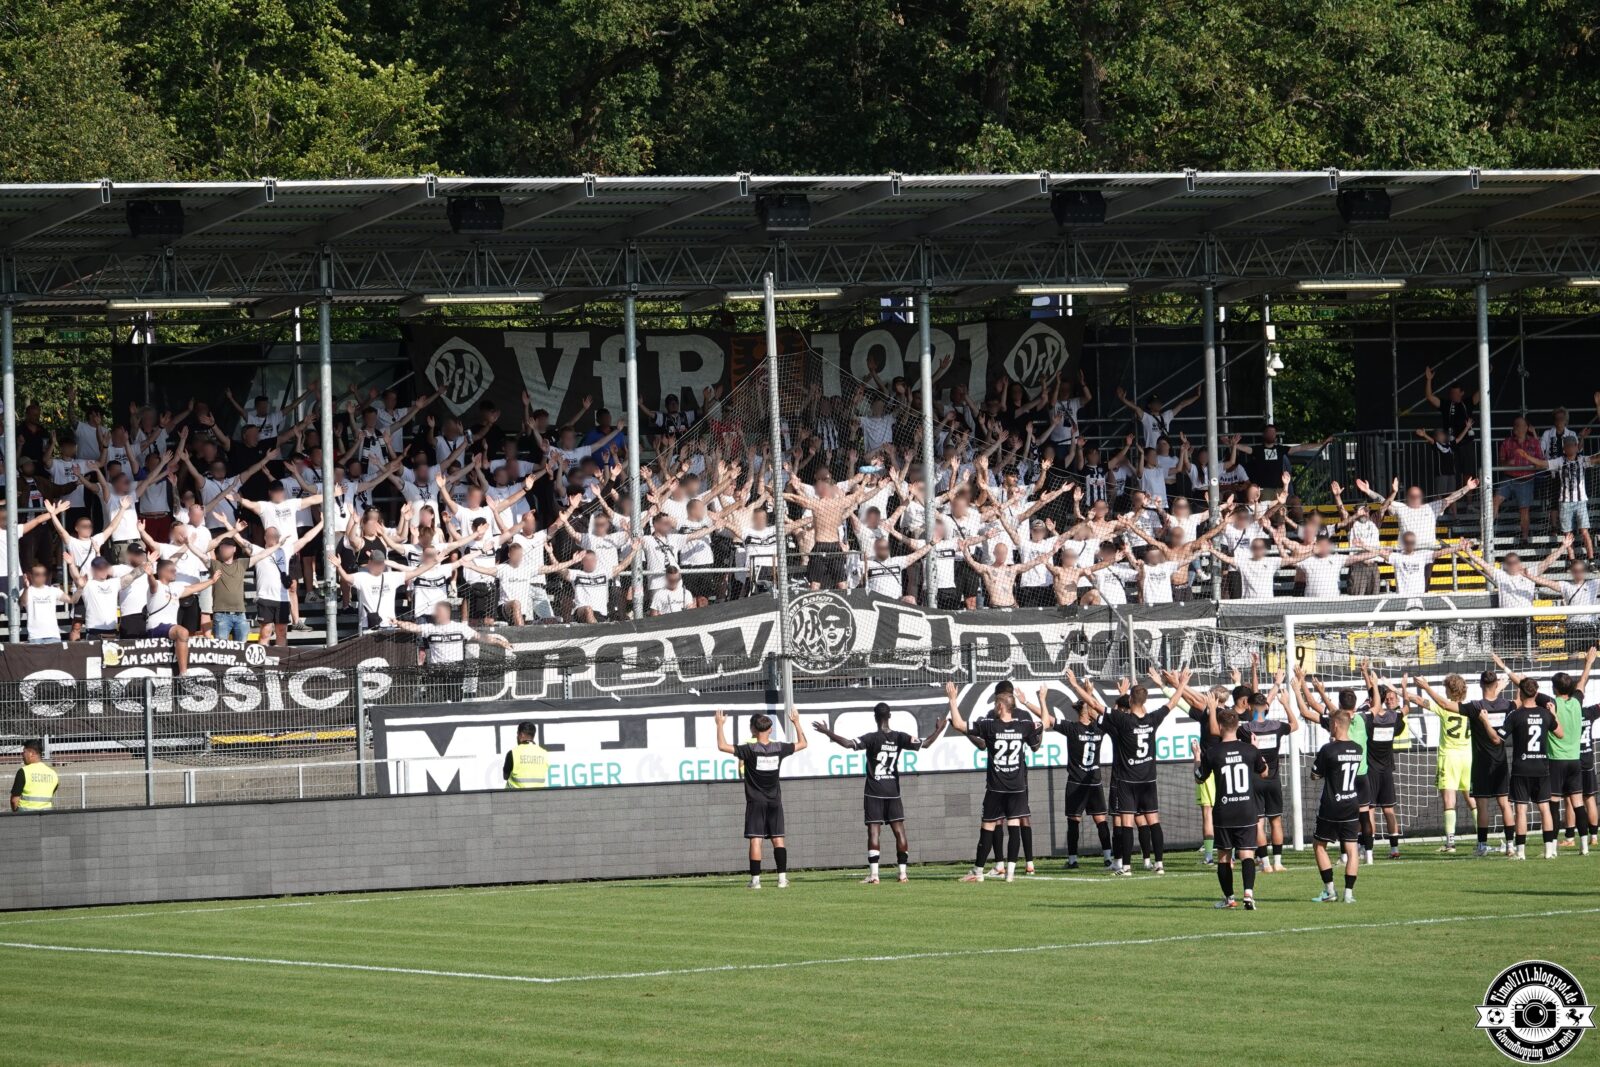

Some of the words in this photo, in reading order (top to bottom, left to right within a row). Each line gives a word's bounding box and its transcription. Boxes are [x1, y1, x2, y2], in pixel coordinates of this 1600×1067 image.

[503, 331, 725, 427] VfR
[811, 322, 990, 401] 1921
[188, 638, 212, 649] MAN
[213, 638, 246, 650] SONST
[121, 657, 139, 666] AM
[189, 653, 247, 667] MACHEN?...
[18, 656, 392, 718] classics
[1136, 733, 1149, 758] 5
[1527, 725, 1541, 752] 2
[519, 754, 544, 765] SECURITY
[874, 752, 898, 776] 27
[994, 740, 1022, 765] 22
[1082, 741, 1096, 766] 6
[31, 773, 54, 784] SECURITY
[547, 762, 623, 788] EIGER
[679, 759, 738, 782] GEIG
[1221, 763, 1249, 794] 10
